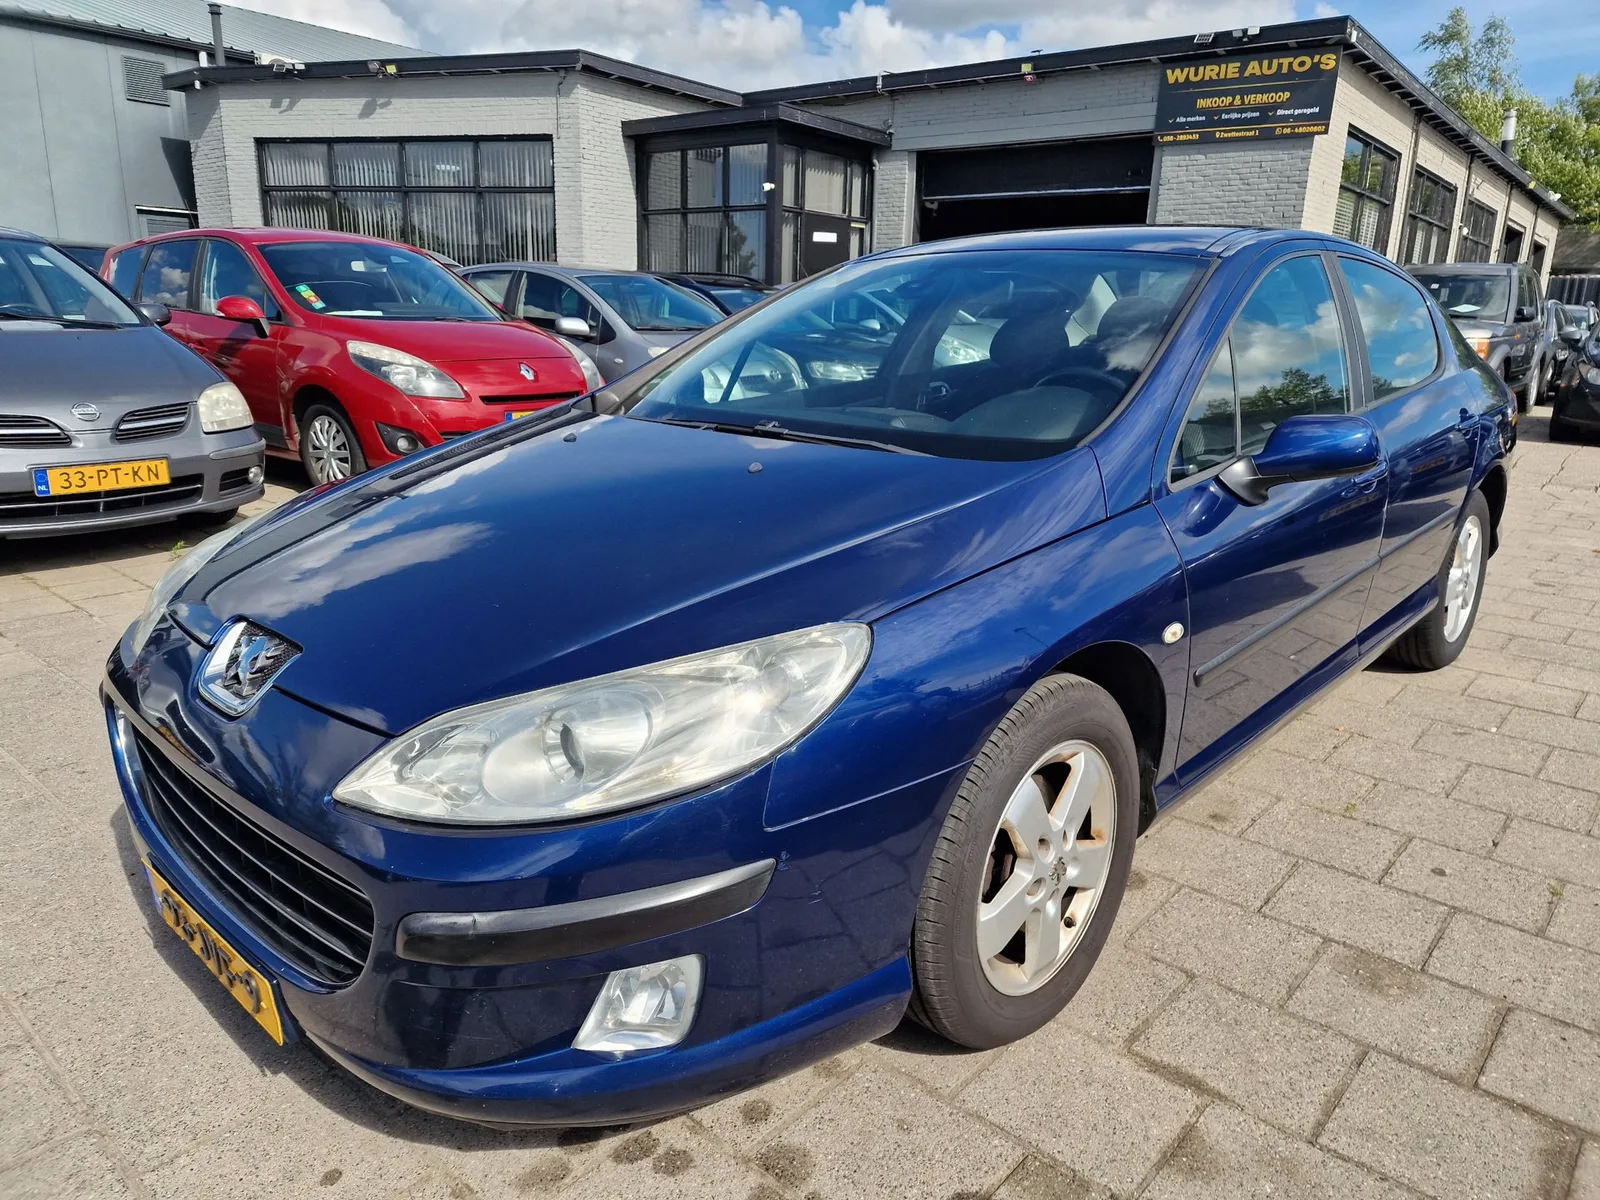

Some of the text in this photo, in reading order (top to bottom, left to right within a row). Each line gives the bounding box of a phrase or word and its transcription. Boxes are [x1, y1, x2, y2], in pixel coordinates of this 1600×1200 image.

[1166, 53, 1337, 85] WURIE AUTO'S
[1196, 91, 1291, 109] INKOOP & VERKOOP
[1276, 106, 1320, 116] Direct geregeld
[59, 463, 160, 490] 33-PT-KN
